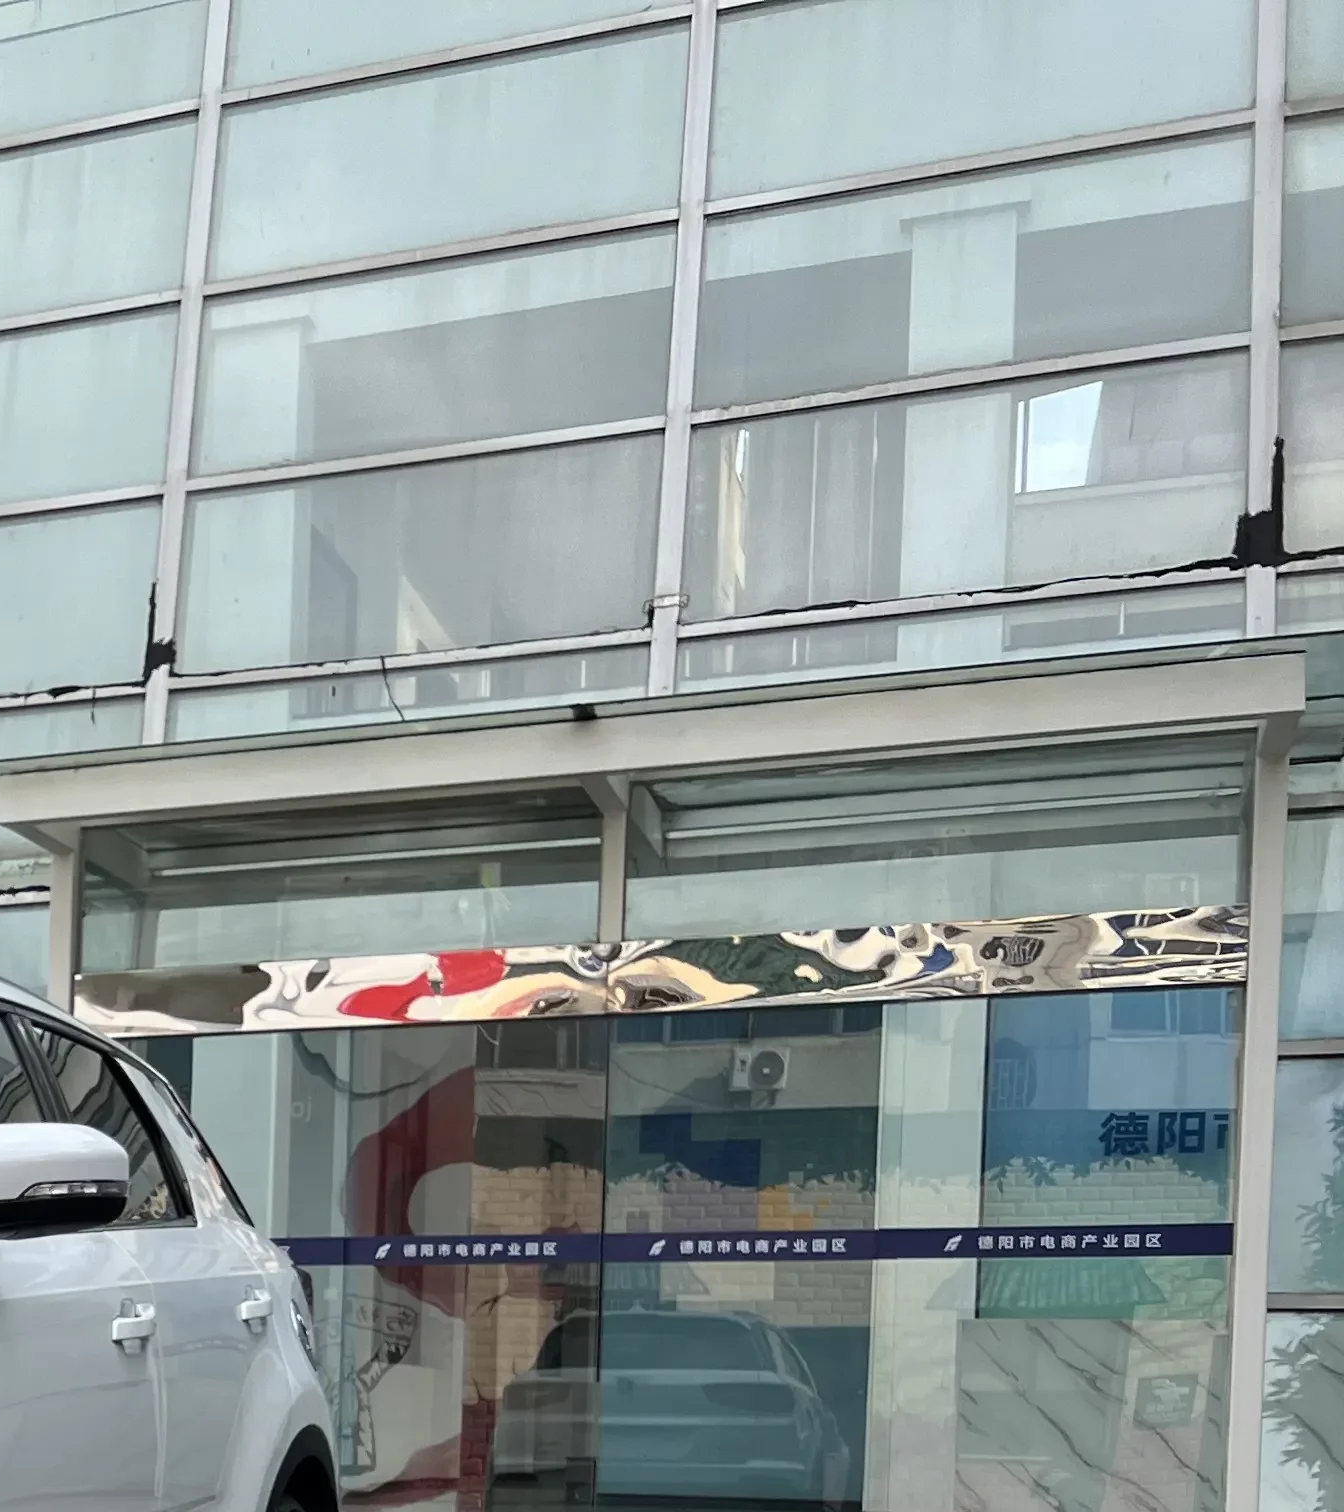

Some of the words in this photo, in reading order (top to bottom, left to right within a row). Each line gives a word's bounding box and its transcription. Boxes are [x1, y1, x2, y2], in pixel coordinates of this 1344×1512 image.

[404, 1242, 557, 1257] 德阳市电商产业园区
[679, 1238, 847, 1255] 德阳市电商产业园区
[978, 1233, 1162, 1250] 德阳市电商产业园区
